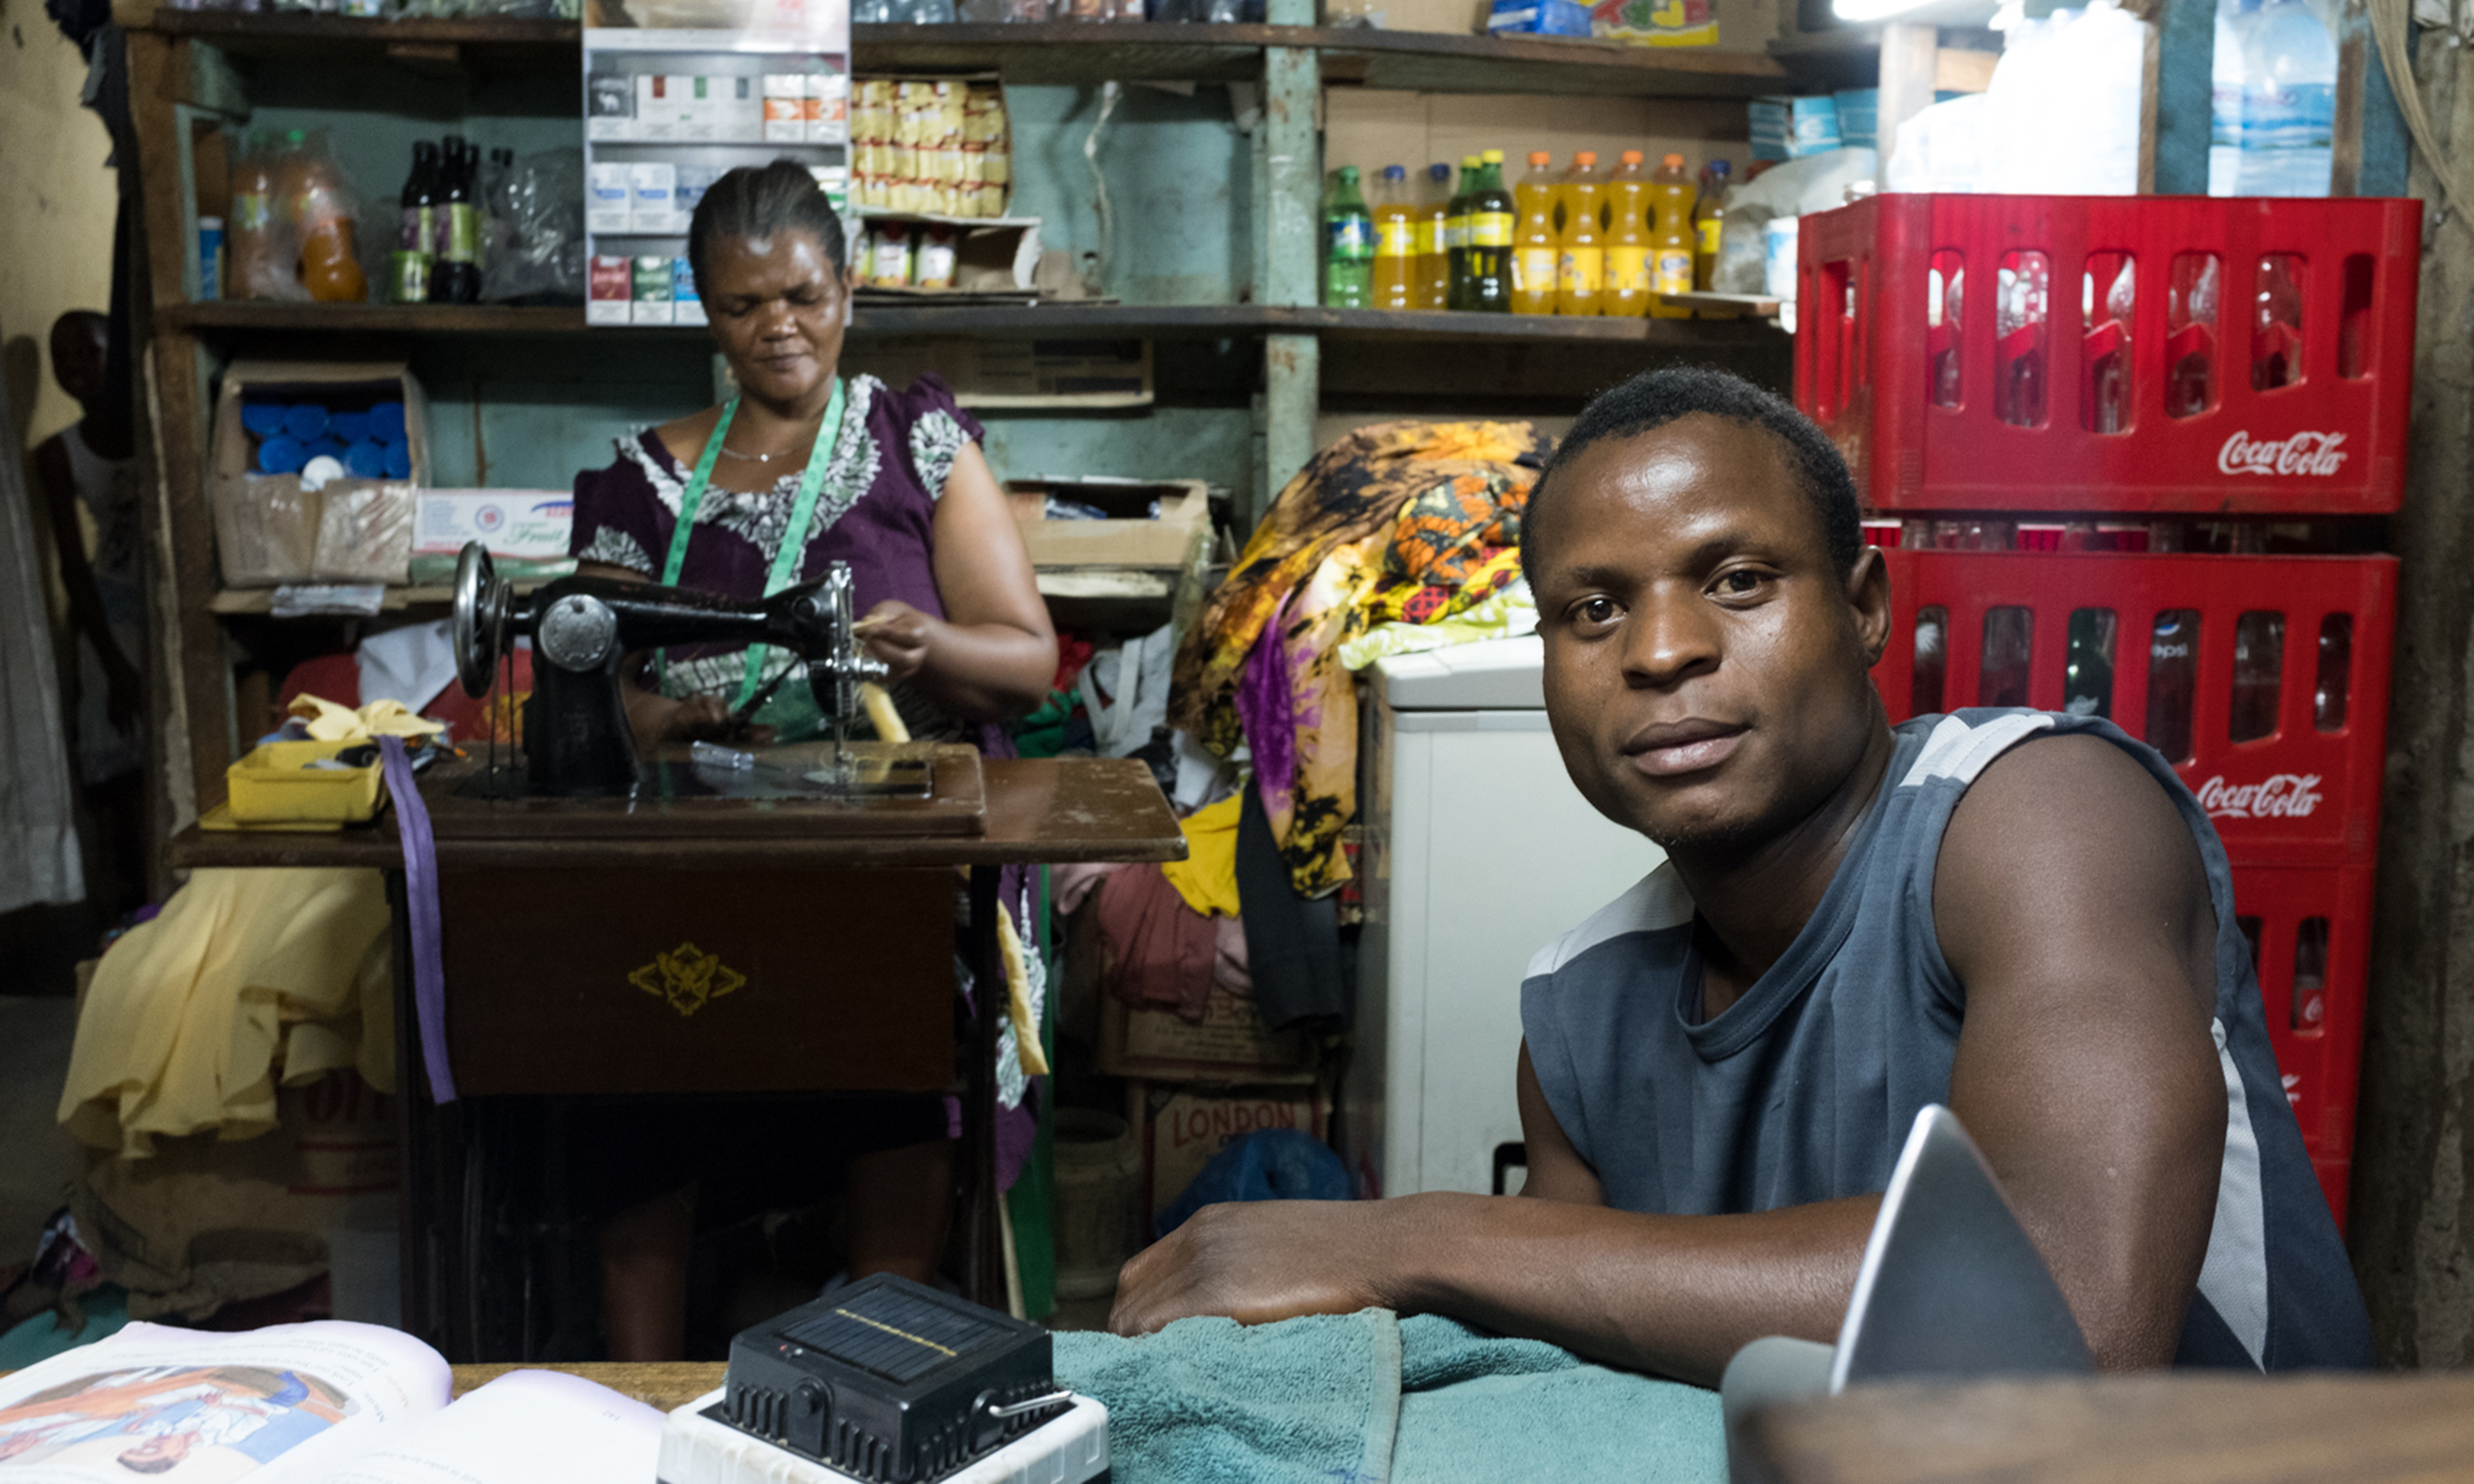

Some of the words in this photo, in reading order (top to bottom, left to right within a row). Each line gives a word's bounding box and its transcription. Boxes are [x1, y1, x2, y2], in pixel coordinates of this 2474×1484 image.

[2218, 429, 2348, 476] Coca-Cola
[2150, 643, 2188, 658] epsi
[2196, 774, 2324, 818] Coca-Cola
[1173, 1101, 1295, 1148] LONDON
[602, 1410, 621, 1422] 142
